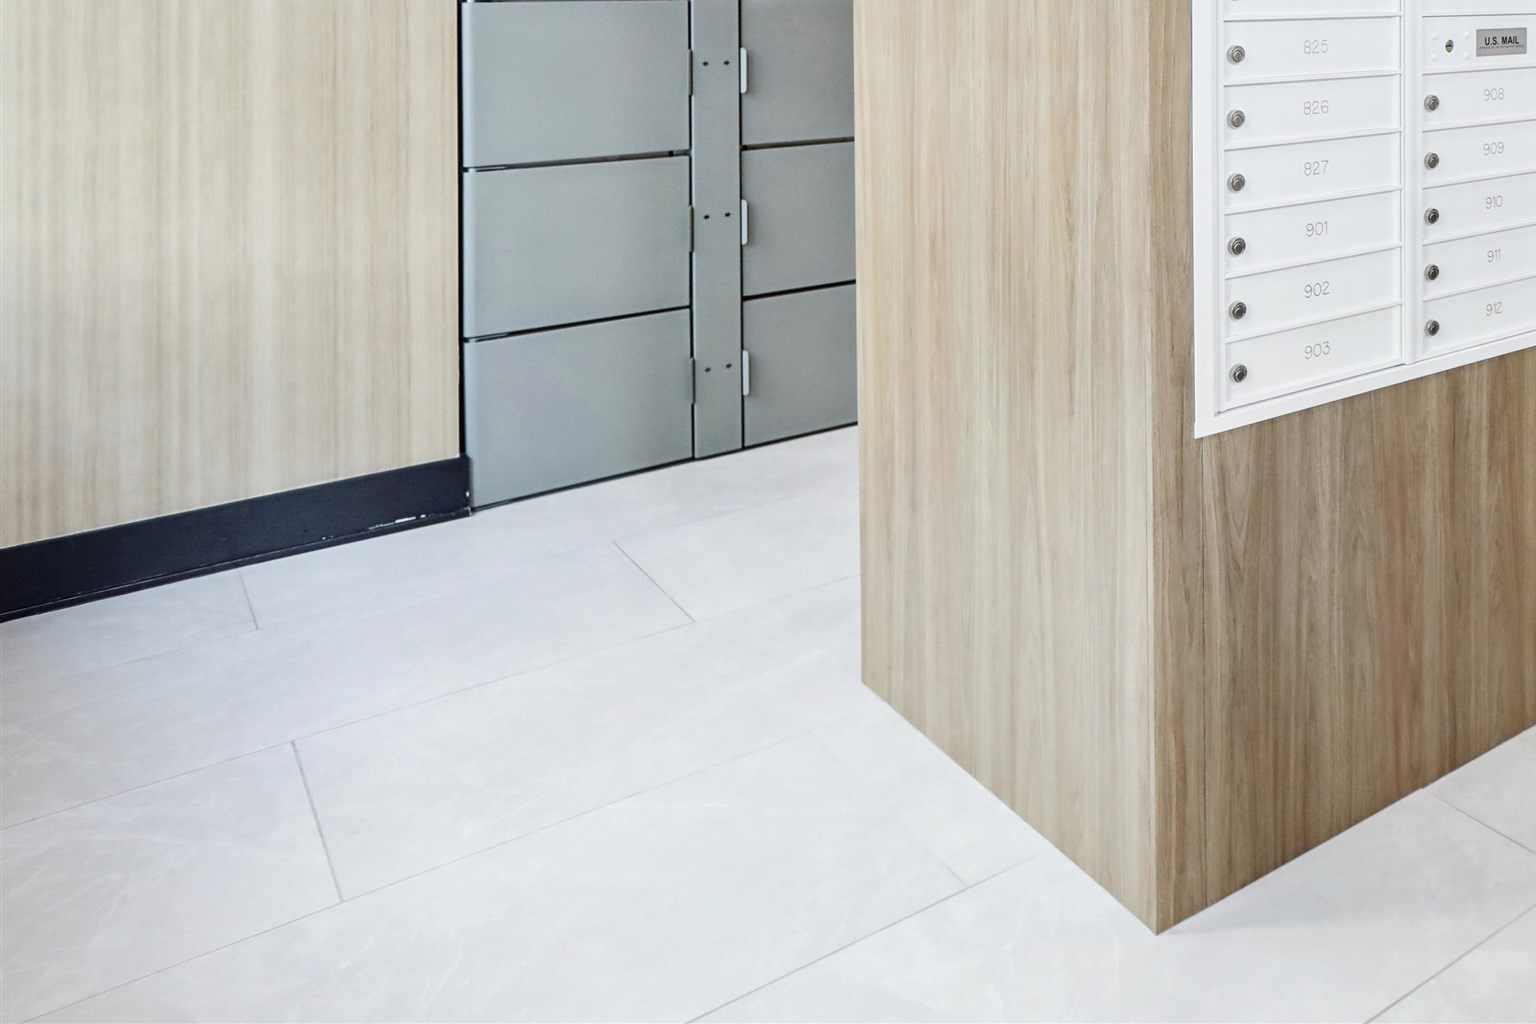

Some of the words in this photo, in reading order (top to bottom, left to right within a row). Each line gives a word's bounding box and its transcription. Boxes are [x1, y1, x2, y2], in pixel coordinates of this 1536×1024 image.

[1303, 40, 1328, 54] 825
[1485, 37, 1499, 45] U.S.
[1502, 36, 1519, 44] MAIL
[1483, 88, 1504, 101] 908
[1303, 100, 1329, 116] 826
[1482, 142, 1504, 156] 909
[1304, 161, 1328, 176] 827
[1485, 195, 1502, 210] 910
[1306, 221, 1328, 236] 901
[1487, 249, 1501, 263] 911
[1304, 281, 1330, 298] 902
[1486, 302, 1502, 316] 912
[1304, 342, 1330, 358] 903
